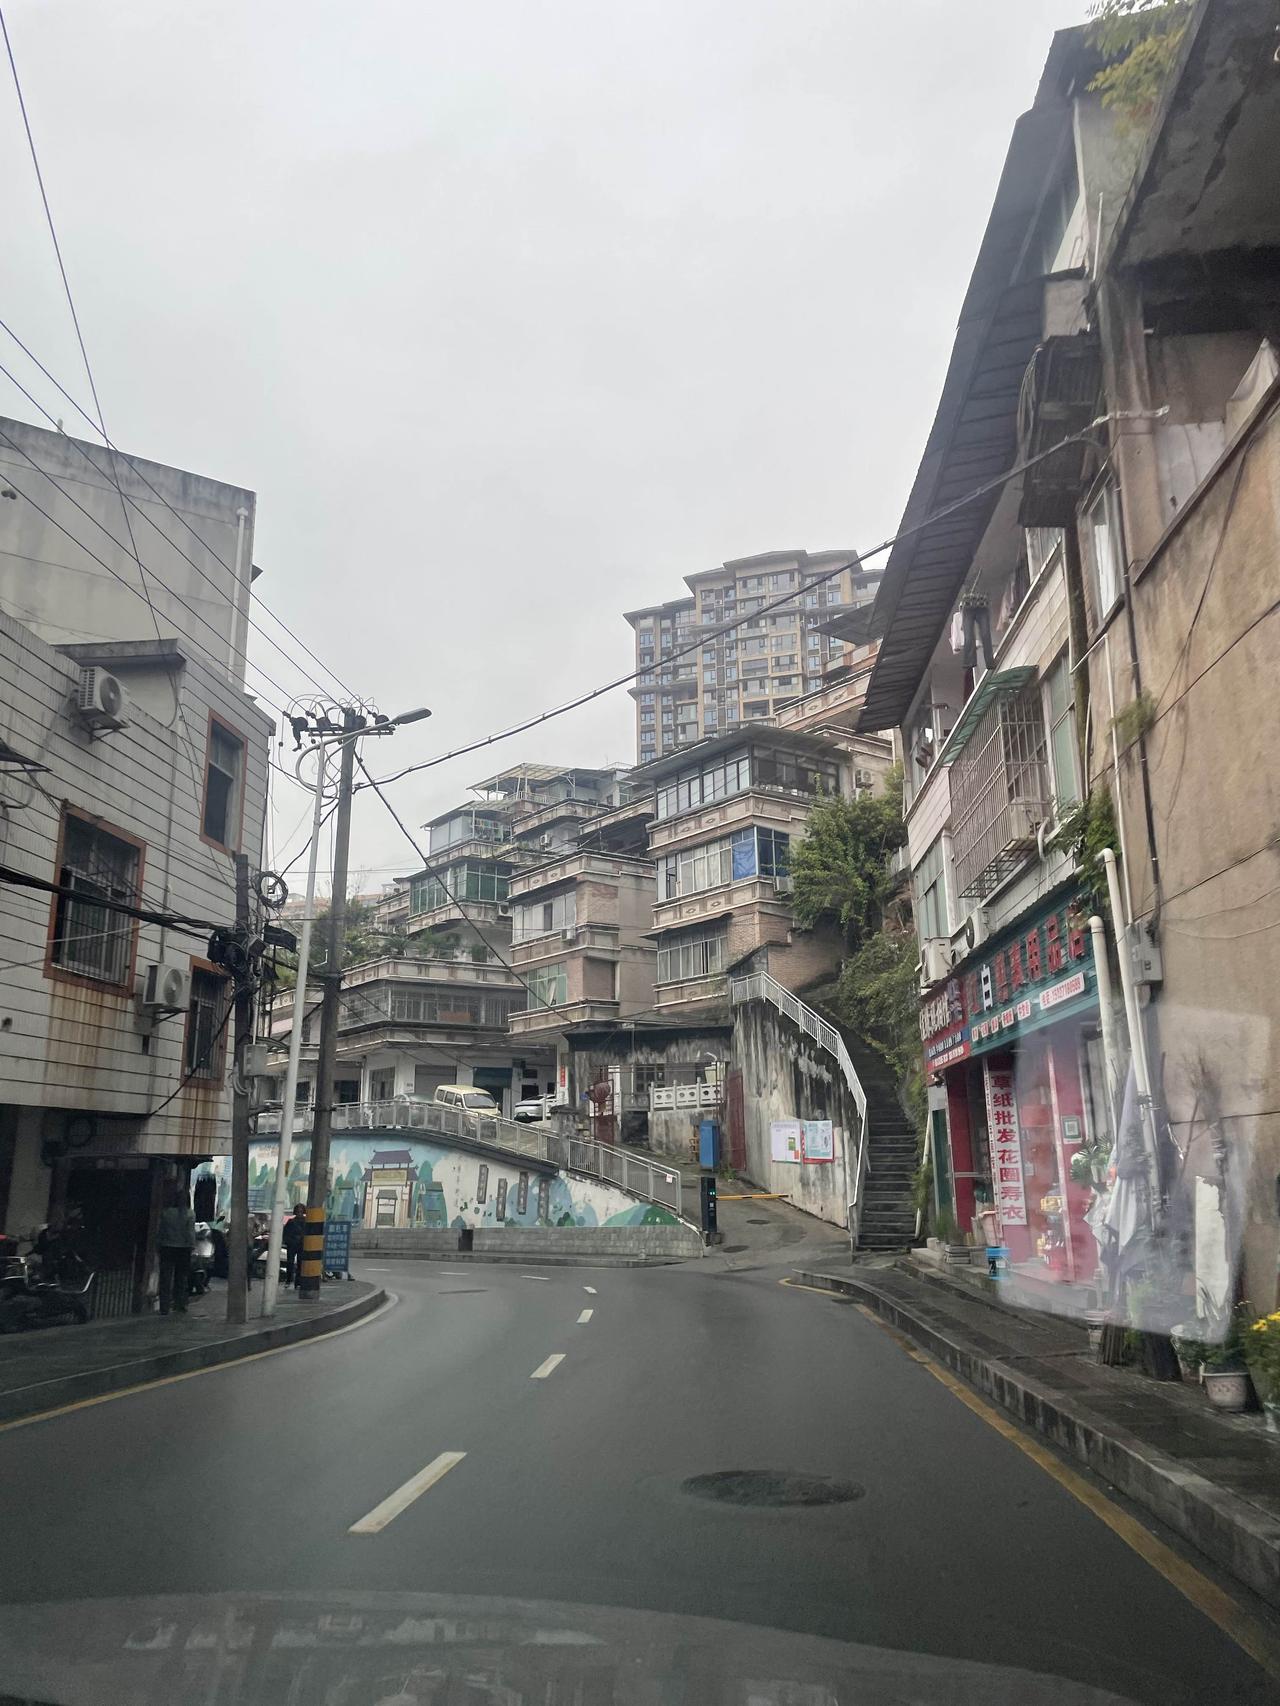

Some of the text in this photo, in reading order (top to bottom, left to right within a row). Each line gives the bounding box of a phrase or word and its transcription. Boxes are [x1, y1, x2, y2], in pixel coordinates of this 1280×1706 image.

[991, 1075, 1025, 1220] 草纸批发花圈寿衣
